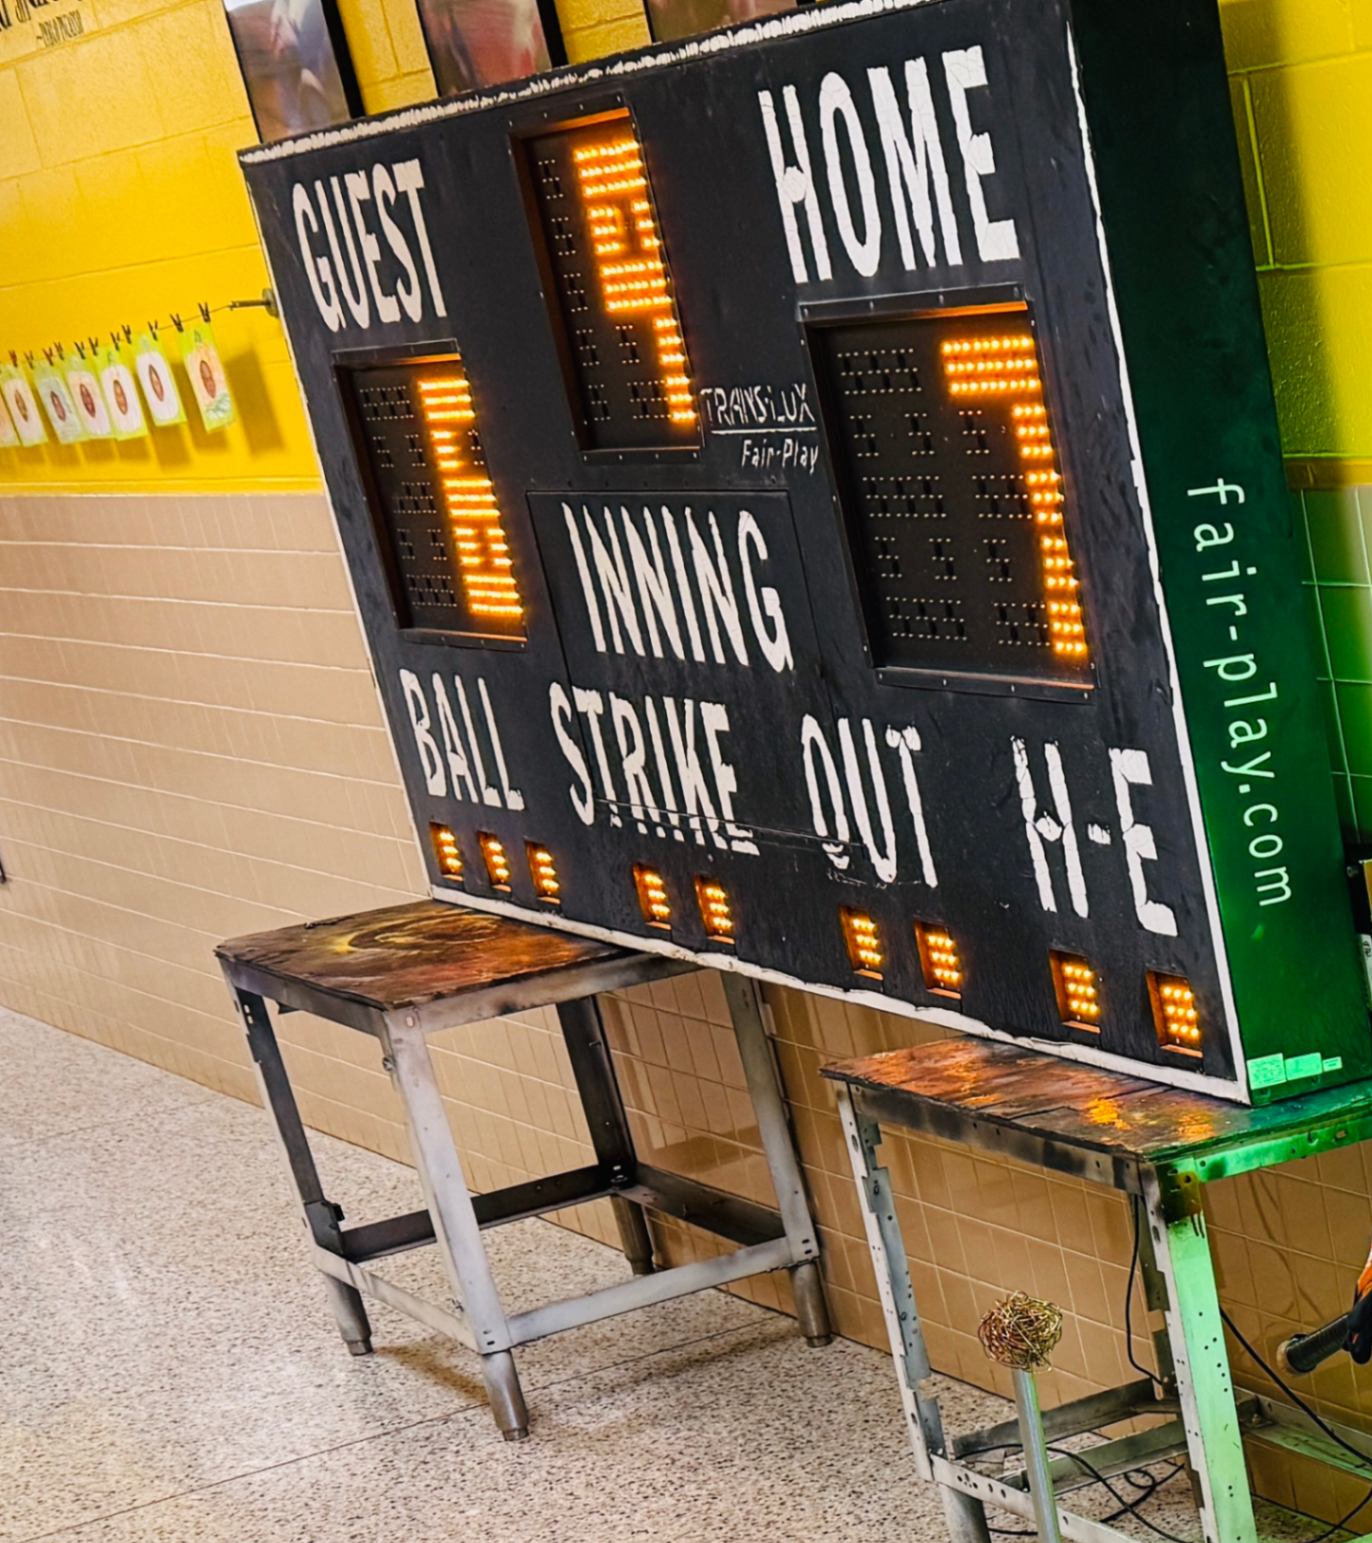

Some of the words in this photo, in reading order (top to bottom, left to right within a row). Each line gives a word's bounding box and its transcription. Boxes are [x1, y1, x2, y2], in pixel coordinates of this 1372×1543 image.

[292, 158, 448, 333] GUEST
[758, 45, 1020, 283] HOME
[742, 438, 818, 475] Fair-Play
[561, 501, 794, 673] INNING
[1186, 477, 1291, 907] fair-play.com
[400, 669, 525, 811] BALL
[549, 681, 760, 856] STRIKE
[800, 714, 938, 889] OUT
[1011, 735, 1178, 937] H-E
